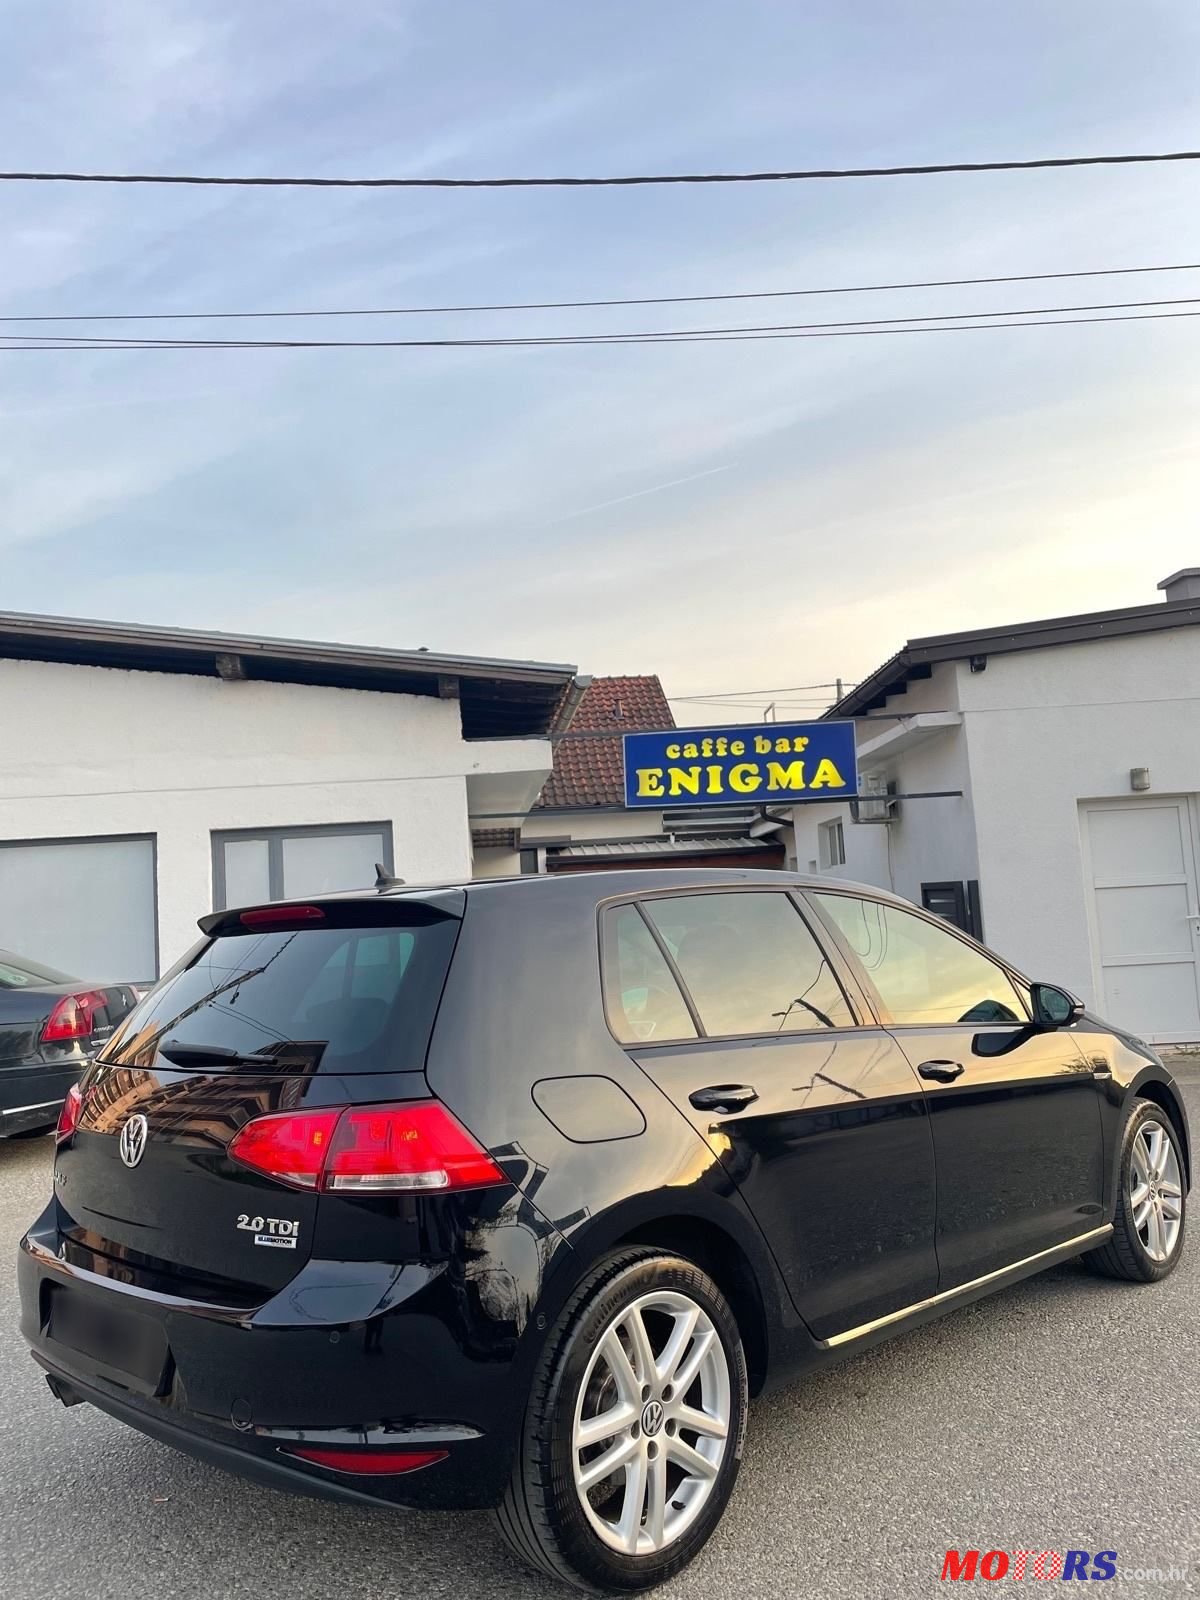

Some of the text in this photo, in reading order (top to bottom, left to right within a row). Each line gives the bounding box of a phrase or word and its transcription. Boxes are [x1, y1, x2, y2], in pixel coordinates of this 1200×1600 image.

[666, 735, 809, 759] caffe bar
[635, 758, 846, 797] ENIGMA
